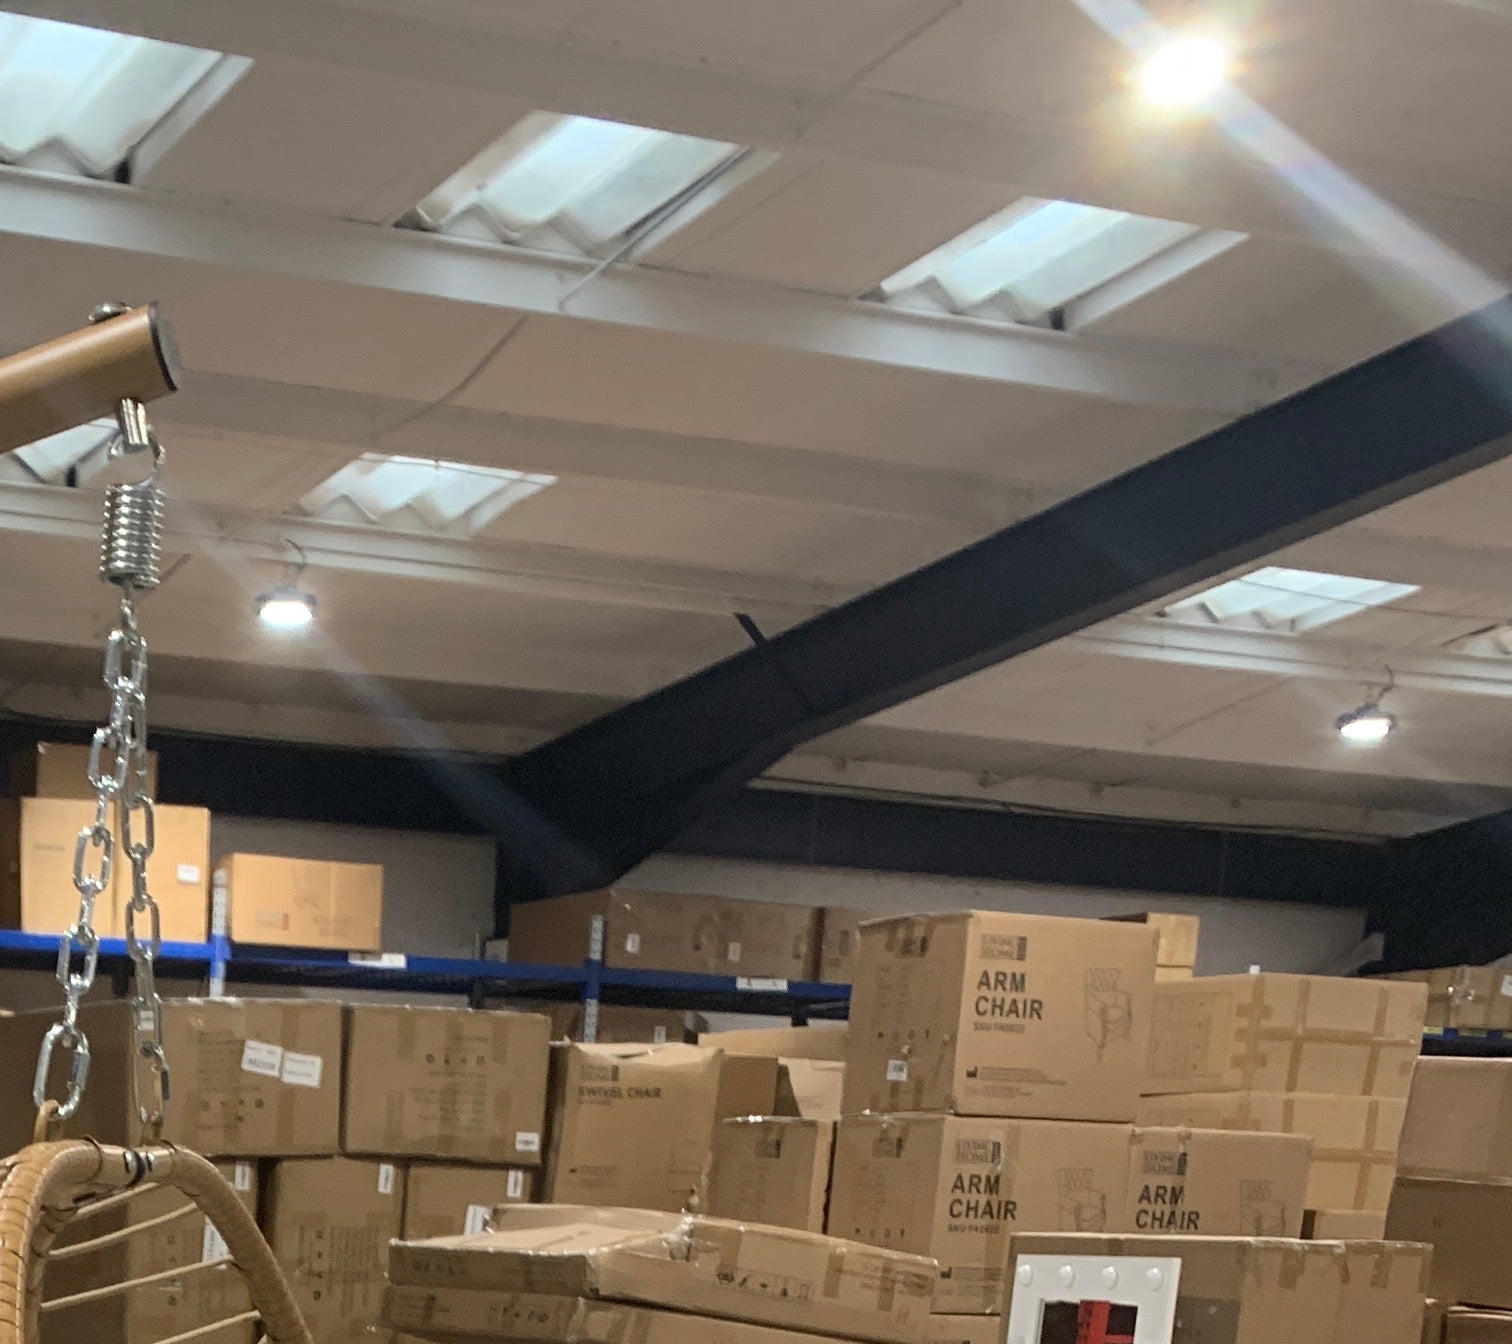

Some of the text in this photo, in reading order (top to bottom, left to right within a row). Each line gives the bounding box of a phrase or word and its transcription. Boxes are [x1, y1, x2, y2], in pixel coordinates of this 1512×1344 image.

[977, 968, 1026, 993] ARM
[974, 995, 1043, 1020] CHAIR
[951, 1173, 1000, 1196] ARM
[1138, 1185, 1185, 1205] ARM
[948, 1198, 1017, 1221] CHAIR
[1135, 1209, 1200, 1231] CHAIR
